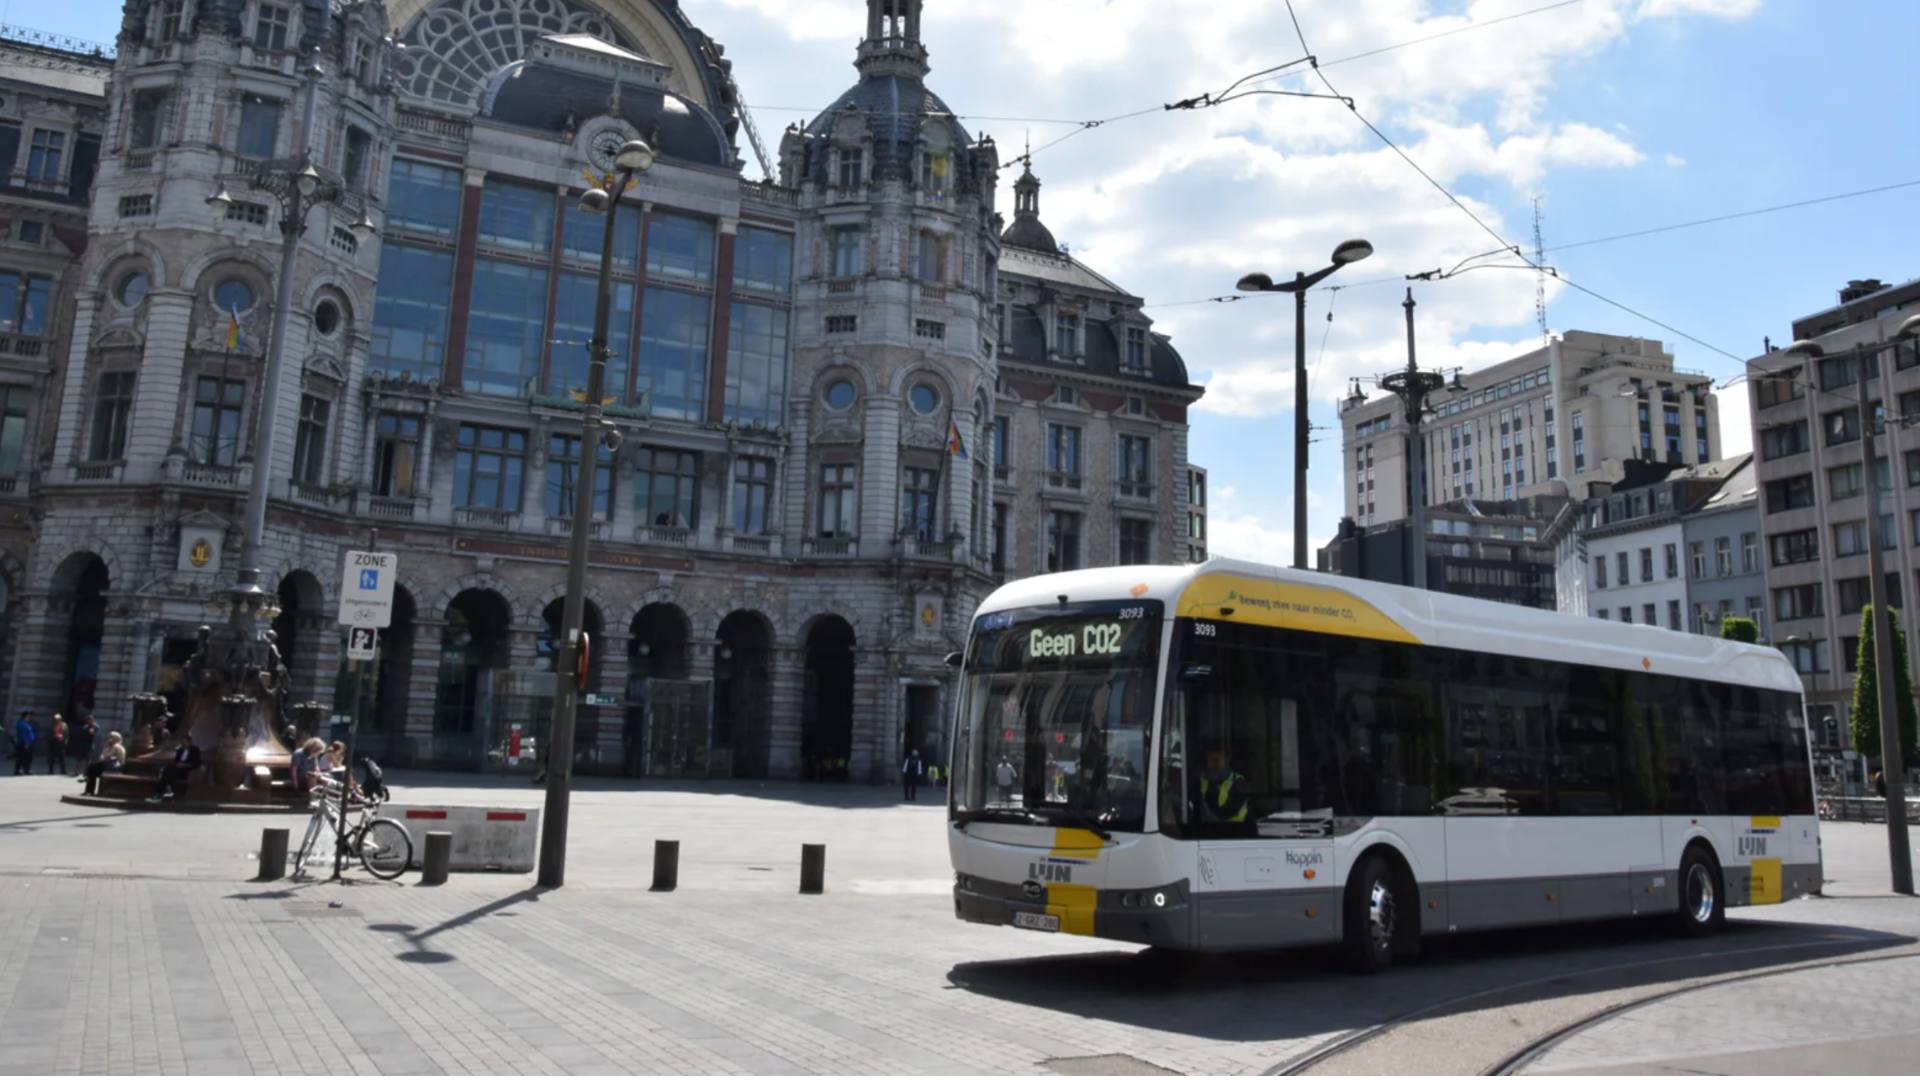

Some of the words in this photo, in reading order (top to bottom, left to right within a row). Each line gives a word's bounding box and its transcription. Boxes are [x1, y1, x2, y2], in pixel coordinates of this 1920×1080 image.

[354, 554, 387, 567] ZONE
[1118, 607, 1144, 620] 3093
[1194, 623, 1216, 637] 3093
[1030, 628, 1075, 657] Geen
[1083, 623, 1121, 655] CO2
[1285, 849, 1323, 867] Hoppin
